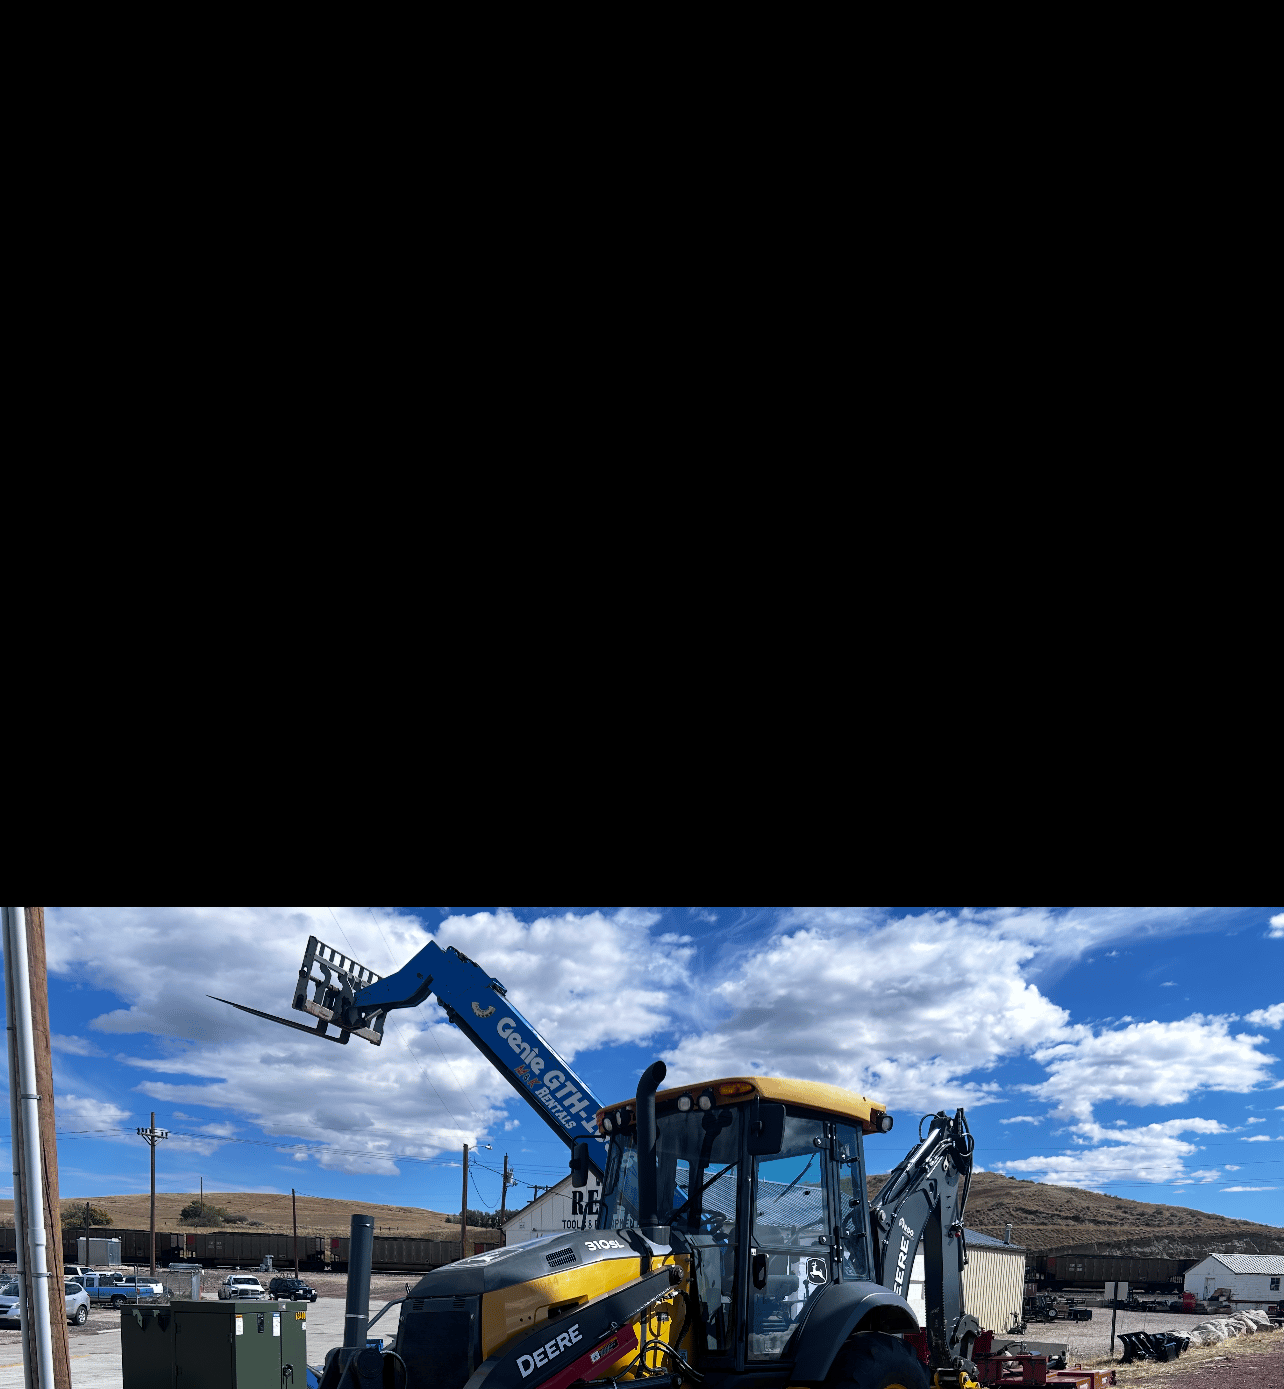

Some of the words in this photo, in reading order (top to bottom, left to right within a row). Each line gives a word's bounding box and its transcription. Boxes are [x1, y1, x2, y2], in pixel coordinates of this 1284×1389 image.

[496, 1016, 545, 1075] Genie
[534, 1086, 577, 1130] RENTALS
[584, 1239, 625, 1252] 310SL
[515, 1323, 583, 1379] DEERE
